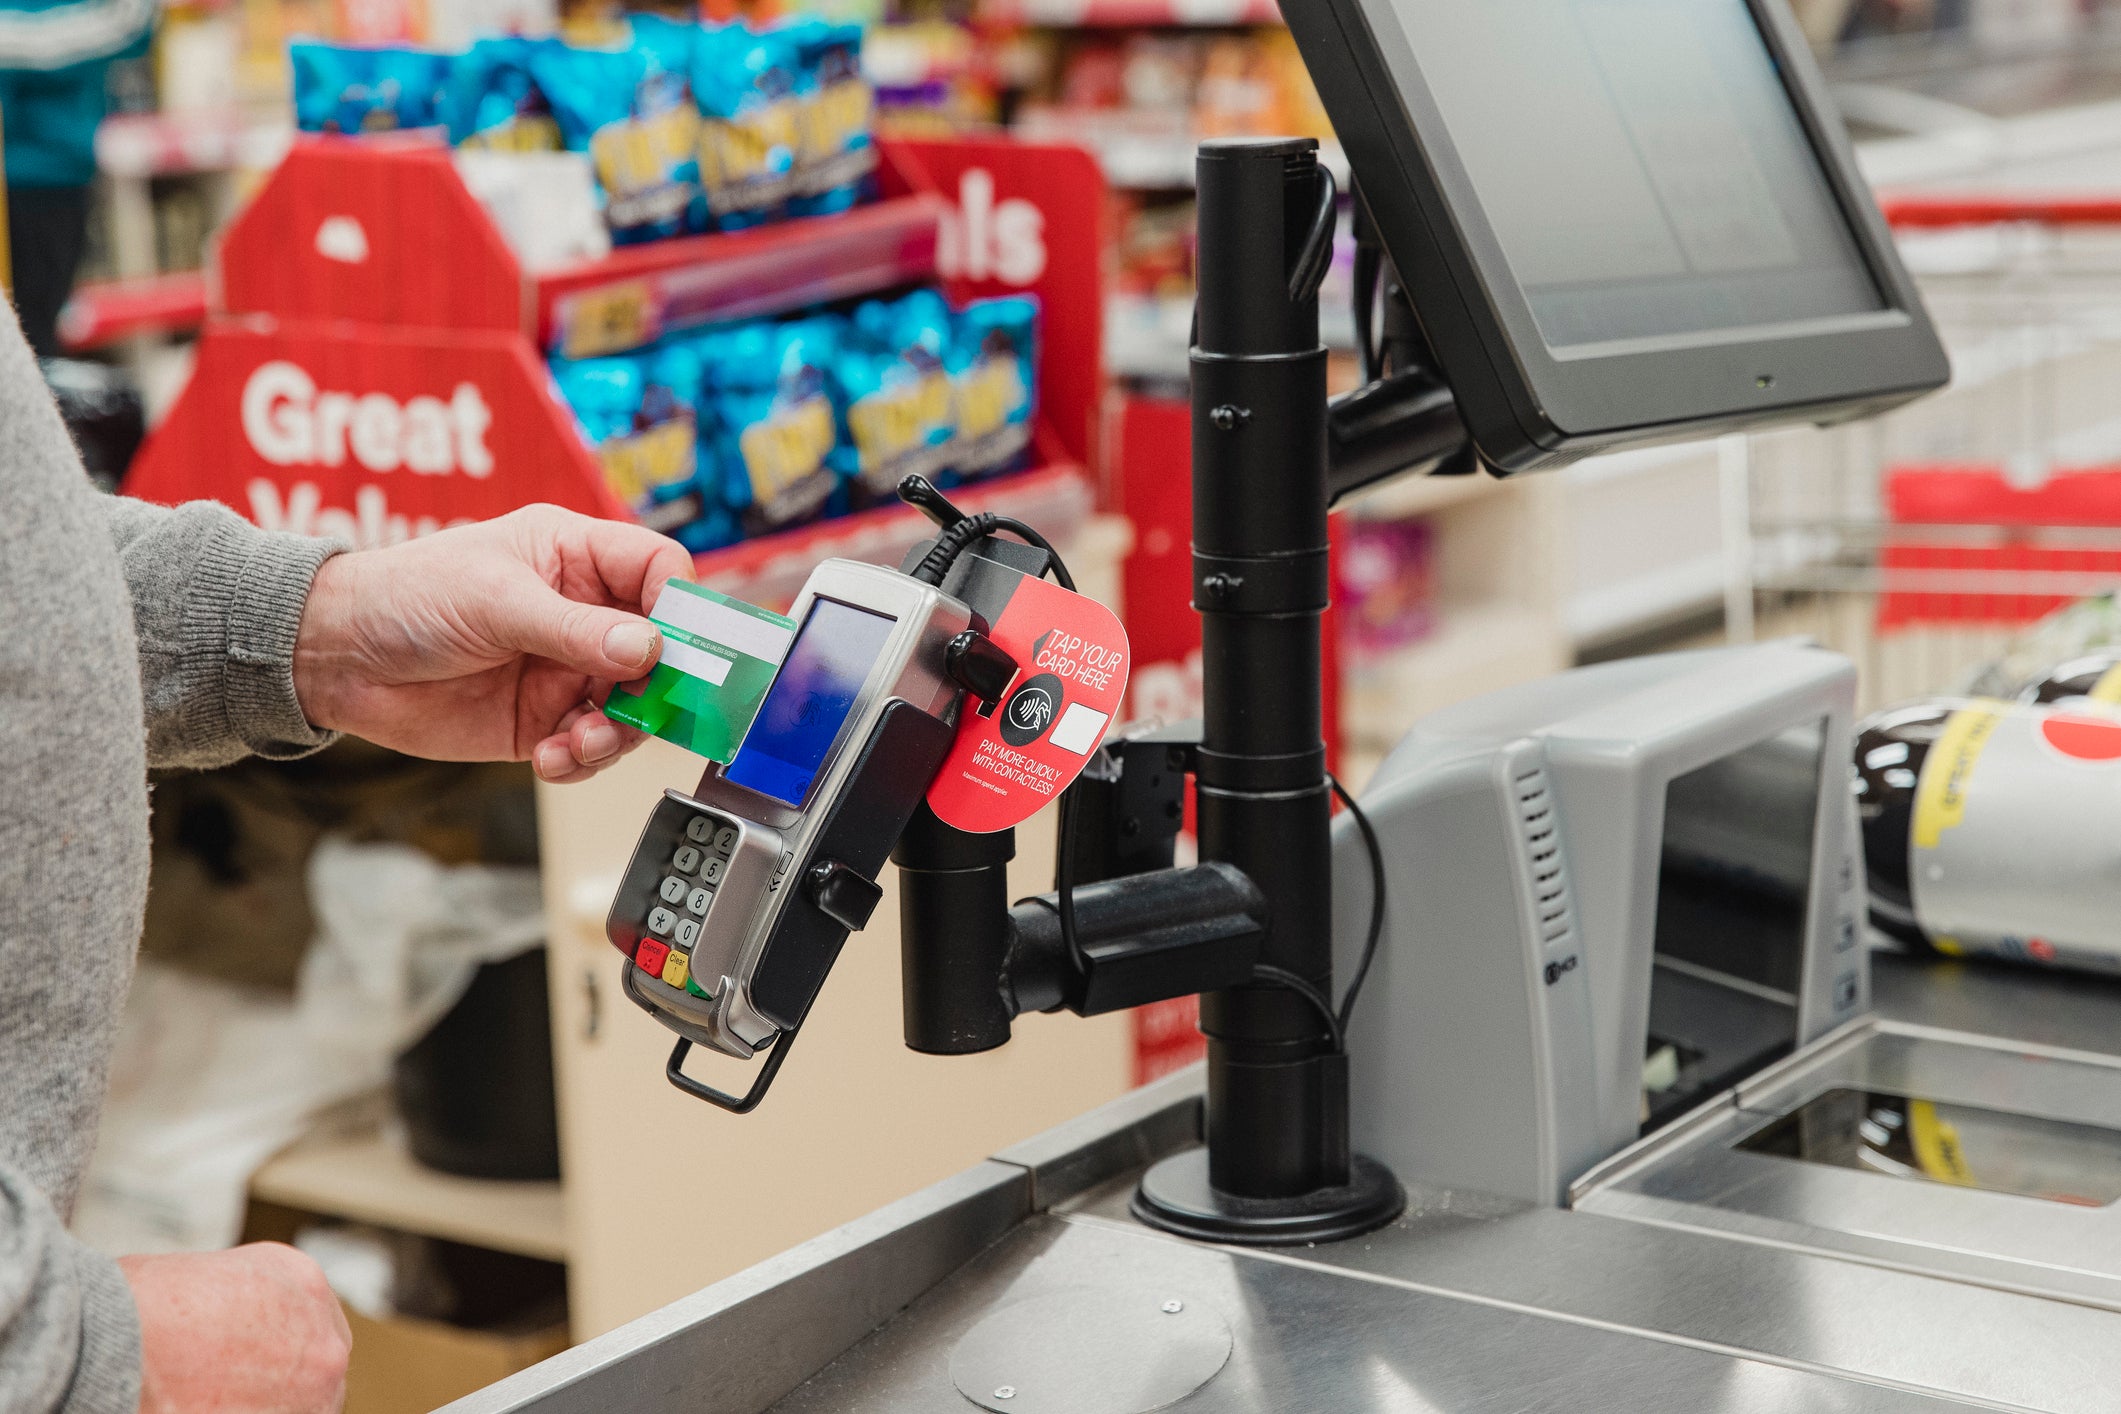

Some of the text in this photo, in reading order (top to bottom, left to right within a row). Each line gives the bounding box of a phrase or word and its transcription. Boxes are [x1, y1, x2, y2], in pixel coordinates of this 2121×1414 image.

[935, 166, 1048, 288] ls
[240, 359, 495, 480] Great
[1048, 628, 1123, 672] TAP YOUR
[1036, 650, 1113, 691] CARD HERE
[972, 752, 1055, 795] WITH CONTACTLESS!
[979, 739, 1062, 782] PAY MORE QUICKLY
[963, 771, 982, 784] Maximum
[981, 780, 995, 791] spend
[697, 822, 732, 847] 1 2
[681, 852, 717, 877] 4 5
[668, 883, 704, 909] 7 8
[684, 925, 692, 940] 0
[642, 941, 686, 966] Cancel Clear
